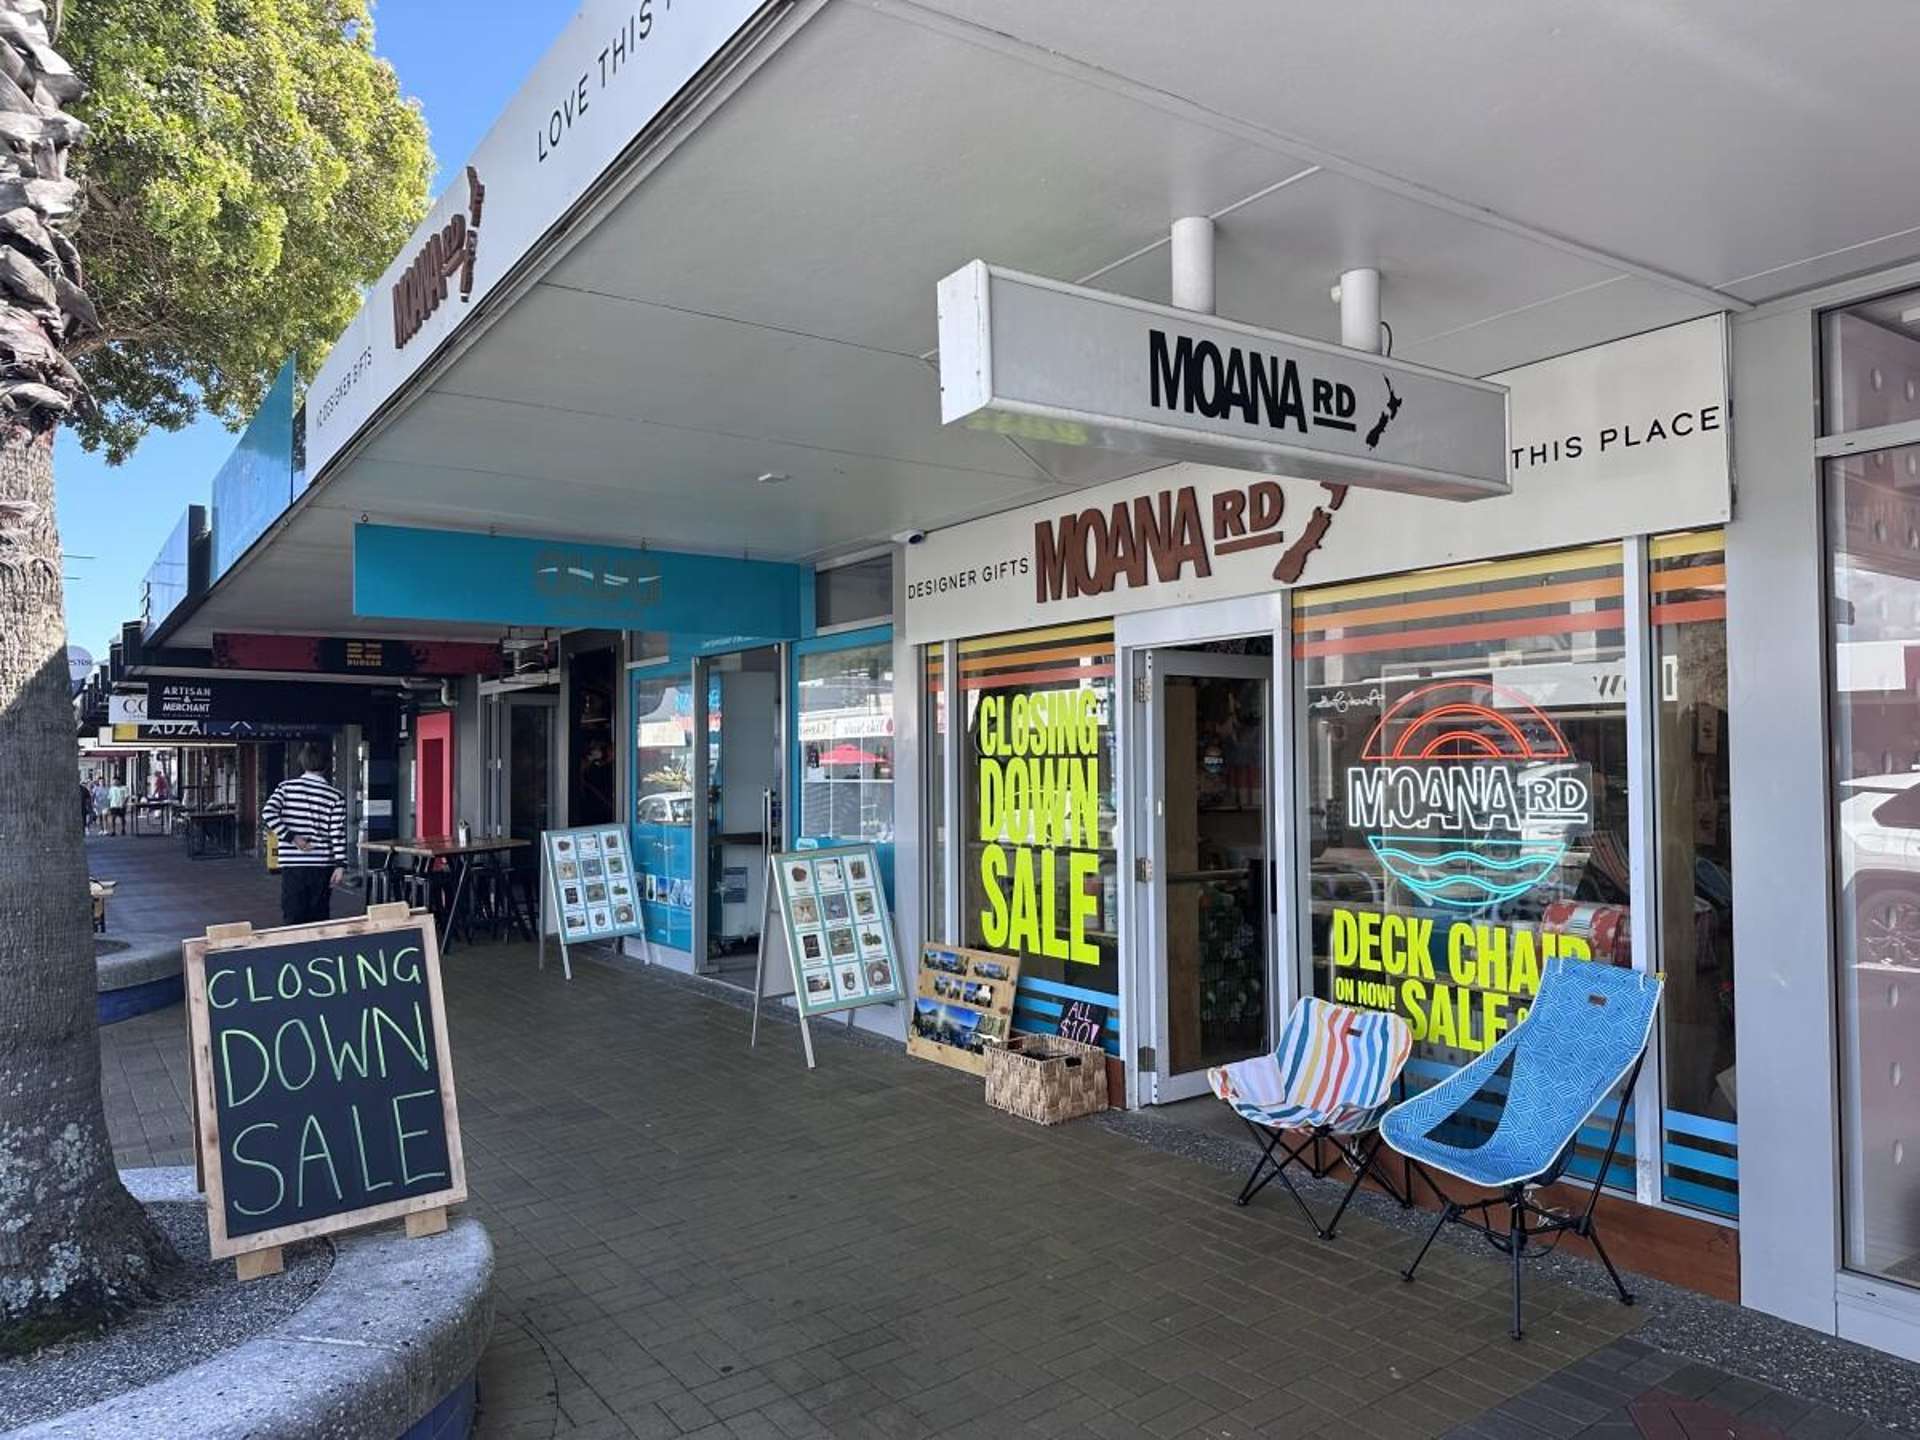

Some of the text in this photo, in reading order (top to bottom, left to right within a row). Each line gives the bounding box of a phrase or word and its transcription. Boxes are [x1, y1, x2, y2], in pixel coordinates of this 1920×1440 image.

[538, 0, 652, 162] LOVE THIS
[353, 345, 373, 383] GIFTS
[1149, 329, 1356, 433] MOANA RD
[1511, 406, 1720, 469] THIS PLACE
[1034, 481, 1286, 603] MOANA RD
[908, 557, 1029, 600] DESIGNER GIFTS
[162, 685, 211, 696] ARTISAN
[162, 702, 210, 712] MERCHANT
[980, 688, 1099, 756] CLOSING
[980, 757, 1099, 849] DOWN
[1347, 766, 1588, 830] MOANA RD
[981, 843, 1100, 966] SALE
[207, 946, 422, 1009] CLOSING
[1333, 908, 1435, 980] DECK
[1068, 1001, 1091, 1022] ALL
[1335, 977, 1396, 1010] ON NOW!
[1401, 978, 1509, 1053] SALE
[221, 1000, 430, 1108] DOWN
[231, 1088, 446, 1216] SALE
